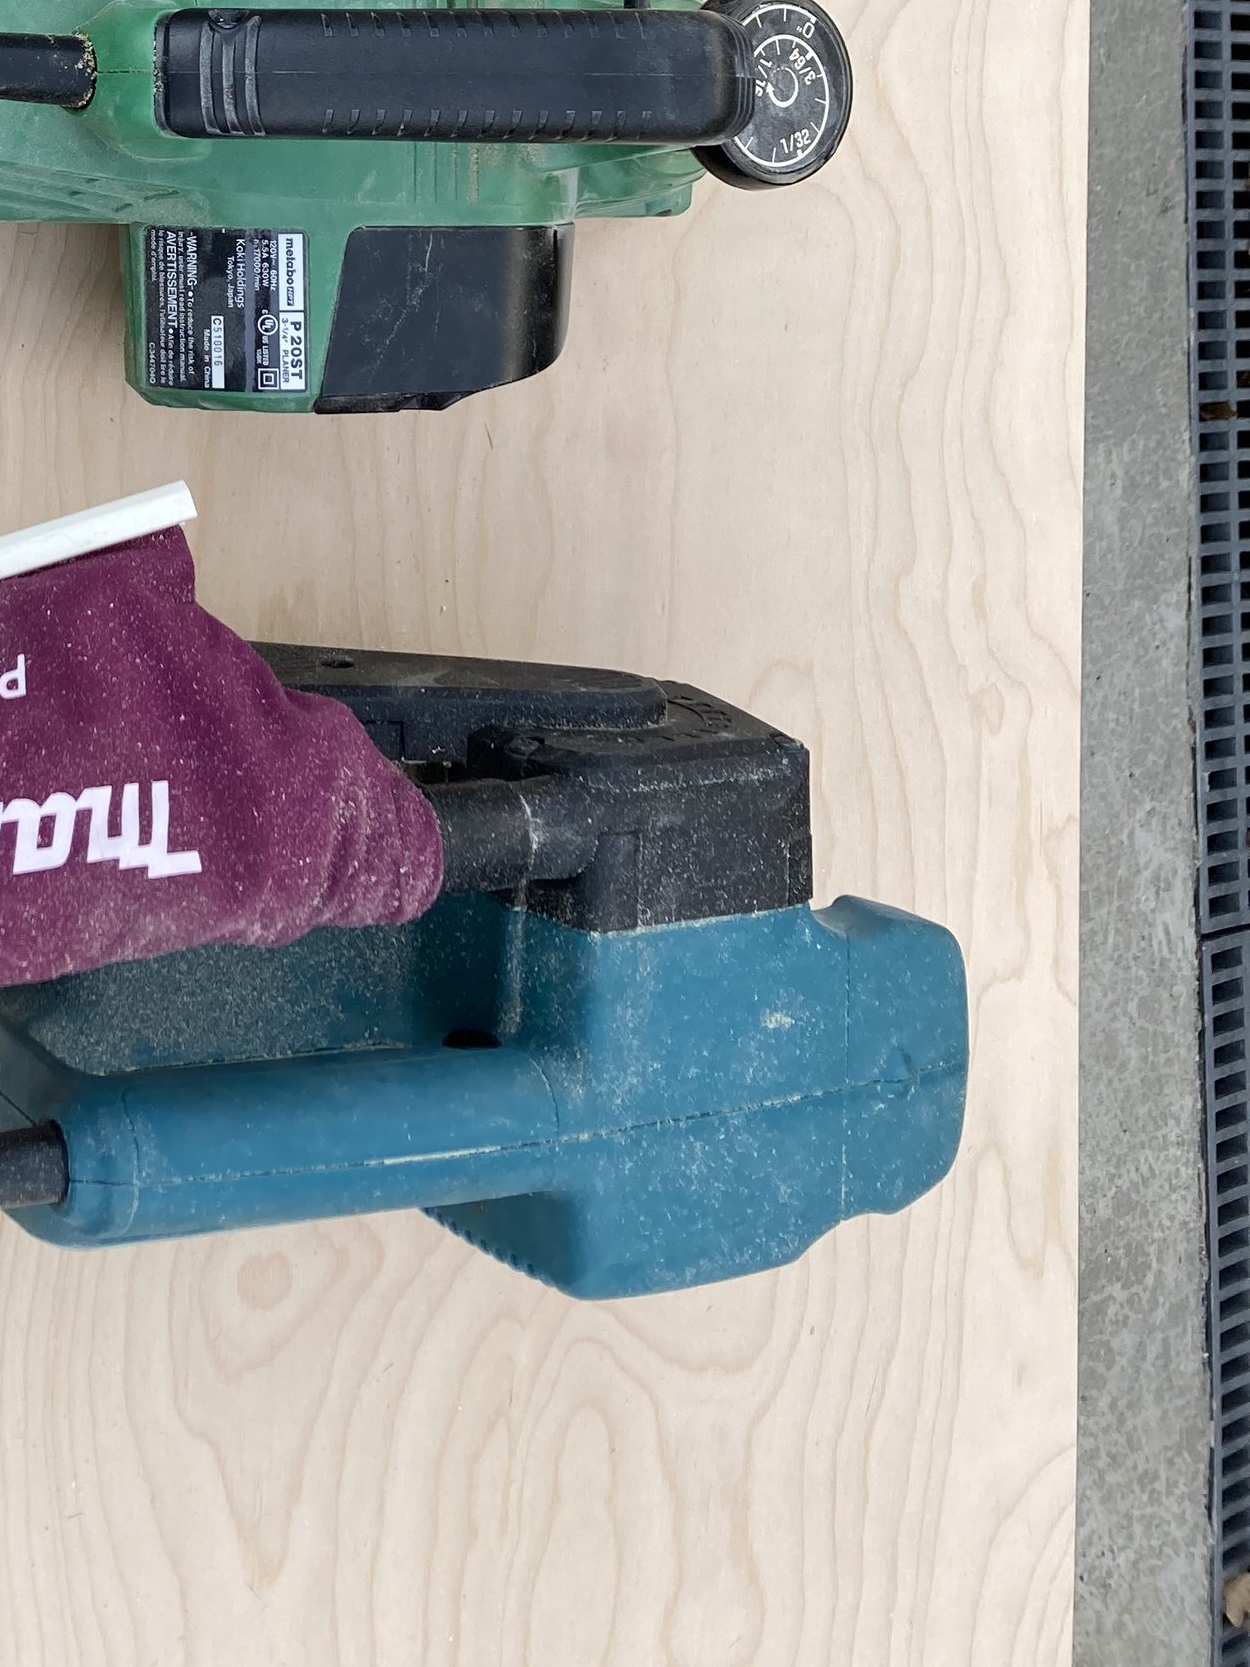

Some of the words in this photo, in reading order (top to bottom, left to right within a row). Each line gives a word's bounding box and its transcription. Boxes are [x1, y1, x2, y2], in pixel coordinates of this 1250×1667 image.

[789, 48, 816, 85] 3/64
[780, 128, 811, 154] 1/32
[235, 238, 245, 262] Koki
[261, 239, 269, 259] 5.5A
[285, 237, 297, 285] metabo
[158, 261, 164, 271] de
[226, 256, 235, 282] Tokyo,
[261, 262, 269, 287] 630W
[166, 230, 178, 328] AVERTISSEMENT
[234, 263, 246, 308] Holdings
[270, 269, 278, 291] 60Hz
[226, 283, 235, 308] Japan
[290, 321, 302, 332] P
[212, 317, 223, 366] C510016
[168, 350, 174, 360] de
[187, 350, 195, 365] risk
[203, 354, 210, 363] in
[282, 349, 290, 383] PLANER
[290, 336, 303, 380] 20ST
[160, 376, 166, 384] le
[188, 365, 195, 374] of
[203, 366, 211, 388] China
